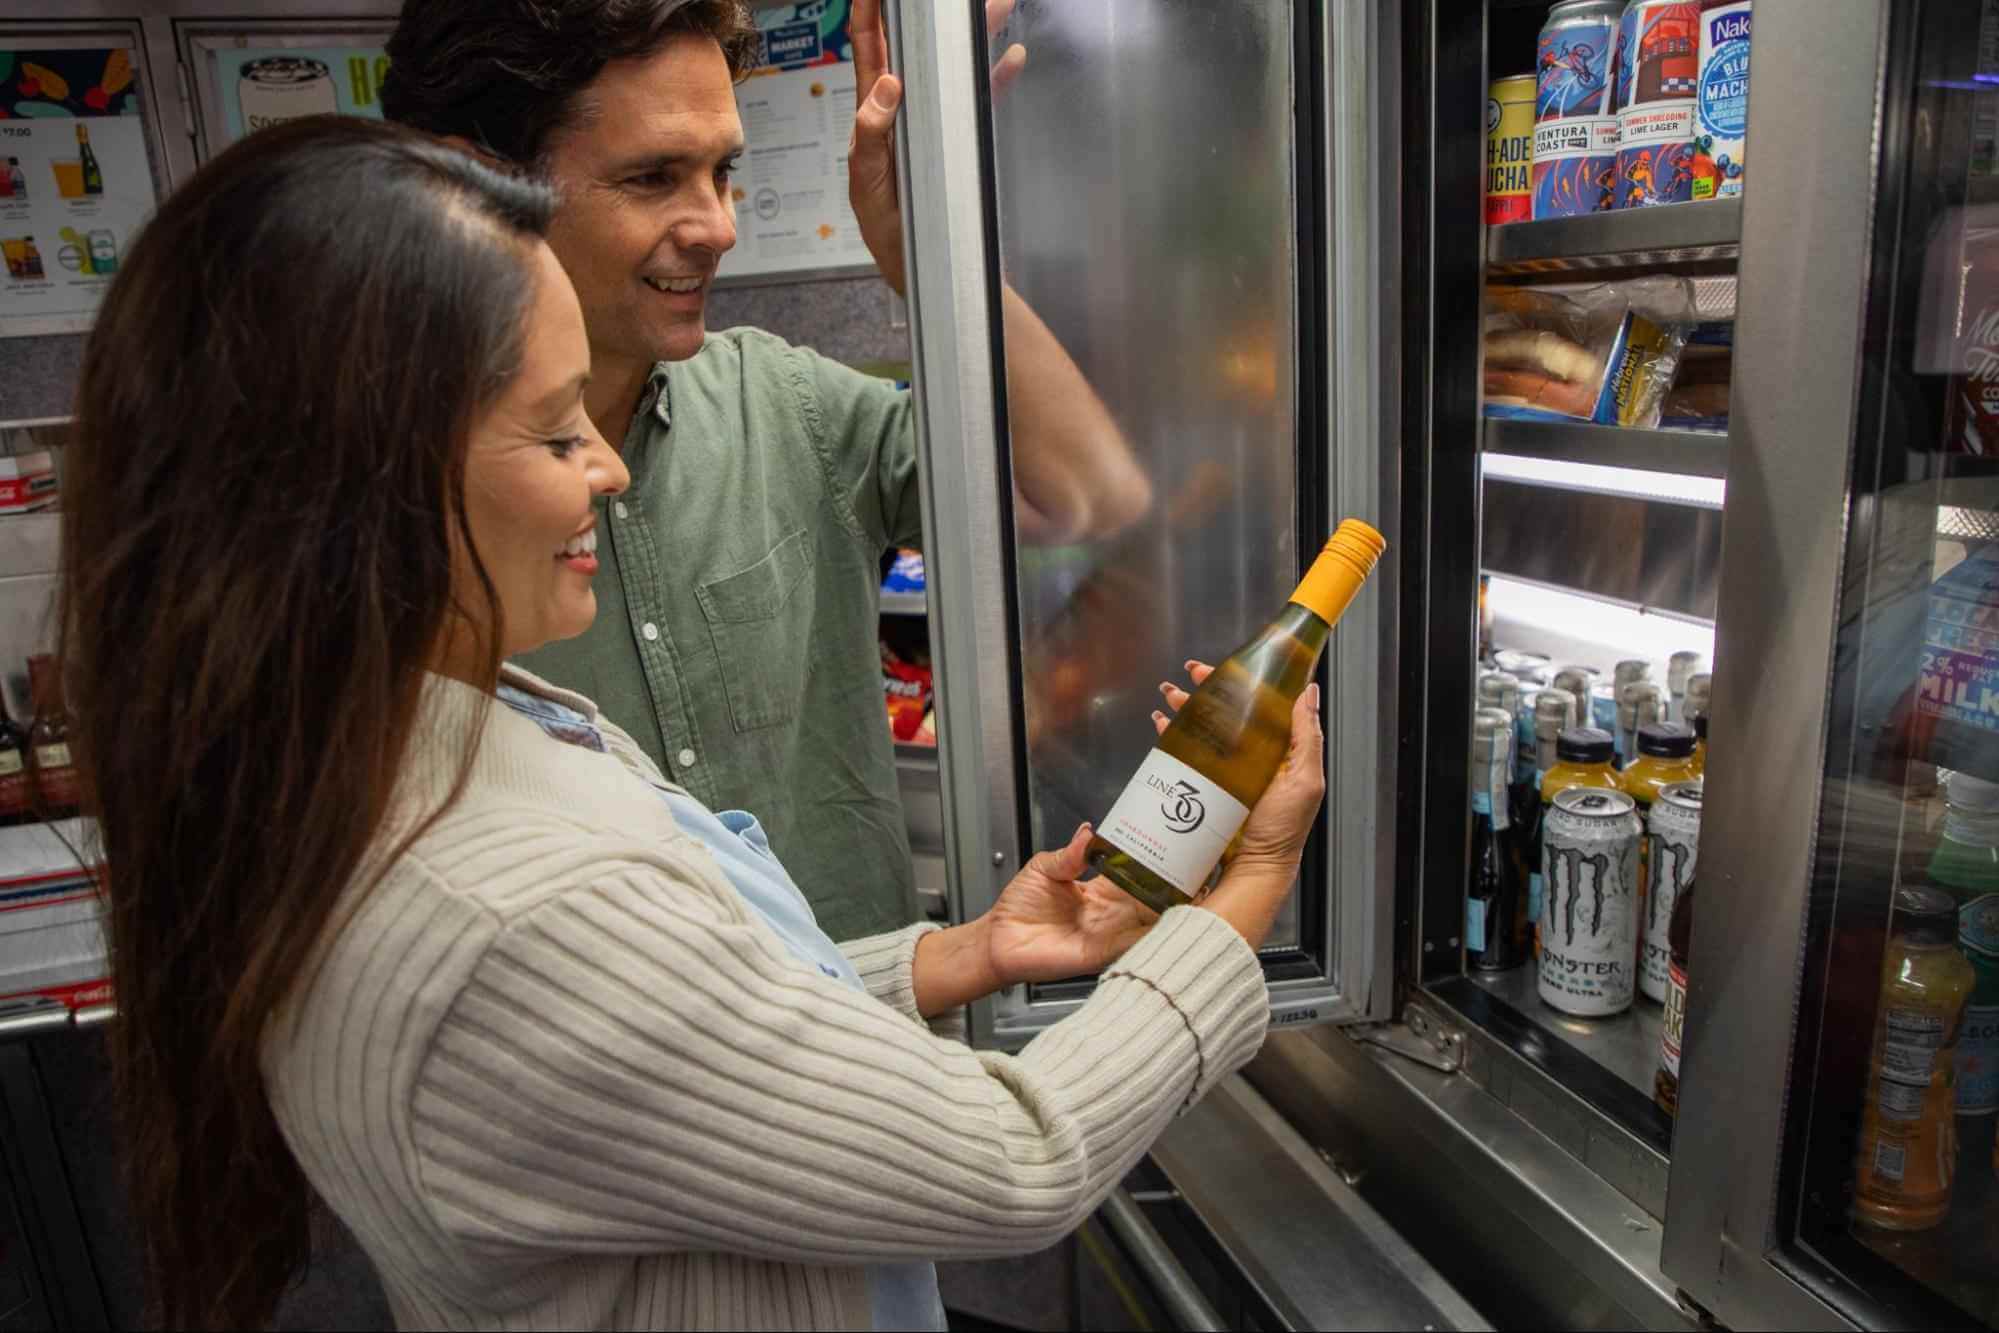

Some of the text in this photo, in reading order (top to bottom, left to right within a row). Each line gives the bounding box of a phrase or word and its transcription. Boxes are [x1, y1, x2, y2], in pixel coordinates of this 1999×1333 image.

[1716, 20, 1752, 41] Nak
[771, 35, 816, 53] MARKET
[1536, 126, 1588, 142] VENTURA
[1630, 122, 1678, 136] LIME LAGER
[1536, 138, 1567, 153] COAST
[1921, 652, 1953, 675] 2%
[1920, 671, 1999, 716] MILK
[1146, 774, 1206, 834] LINE 39
